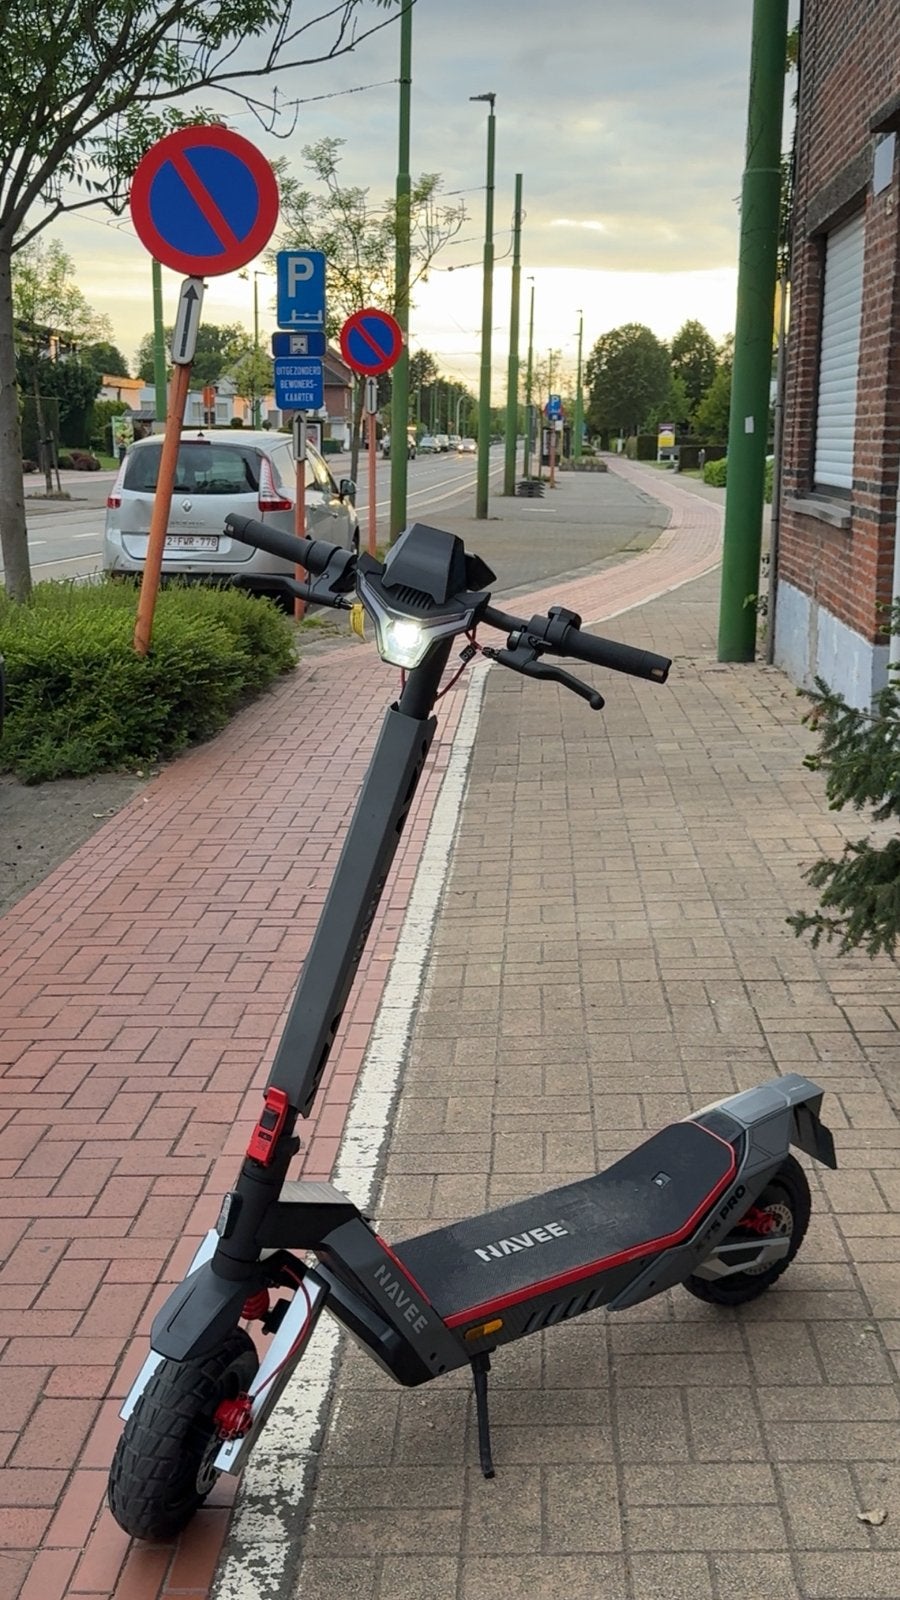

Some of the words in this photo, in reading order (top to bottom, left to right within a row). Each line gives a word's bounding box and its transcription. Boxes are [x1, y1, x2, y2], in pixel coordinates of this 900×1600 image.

[287, 257, 315, 298] P
[276, 366, 321, 376] UITGEZONDERD
[280, 379, 318, 389] BEWONERS-
[285, 392, 314, 402] KAARTEN
[719, 1184, 747, 1220] PRO
[474, 1222, 569, 1262] NAVEE
[374, 1264, 428, 1334] NAVEE
